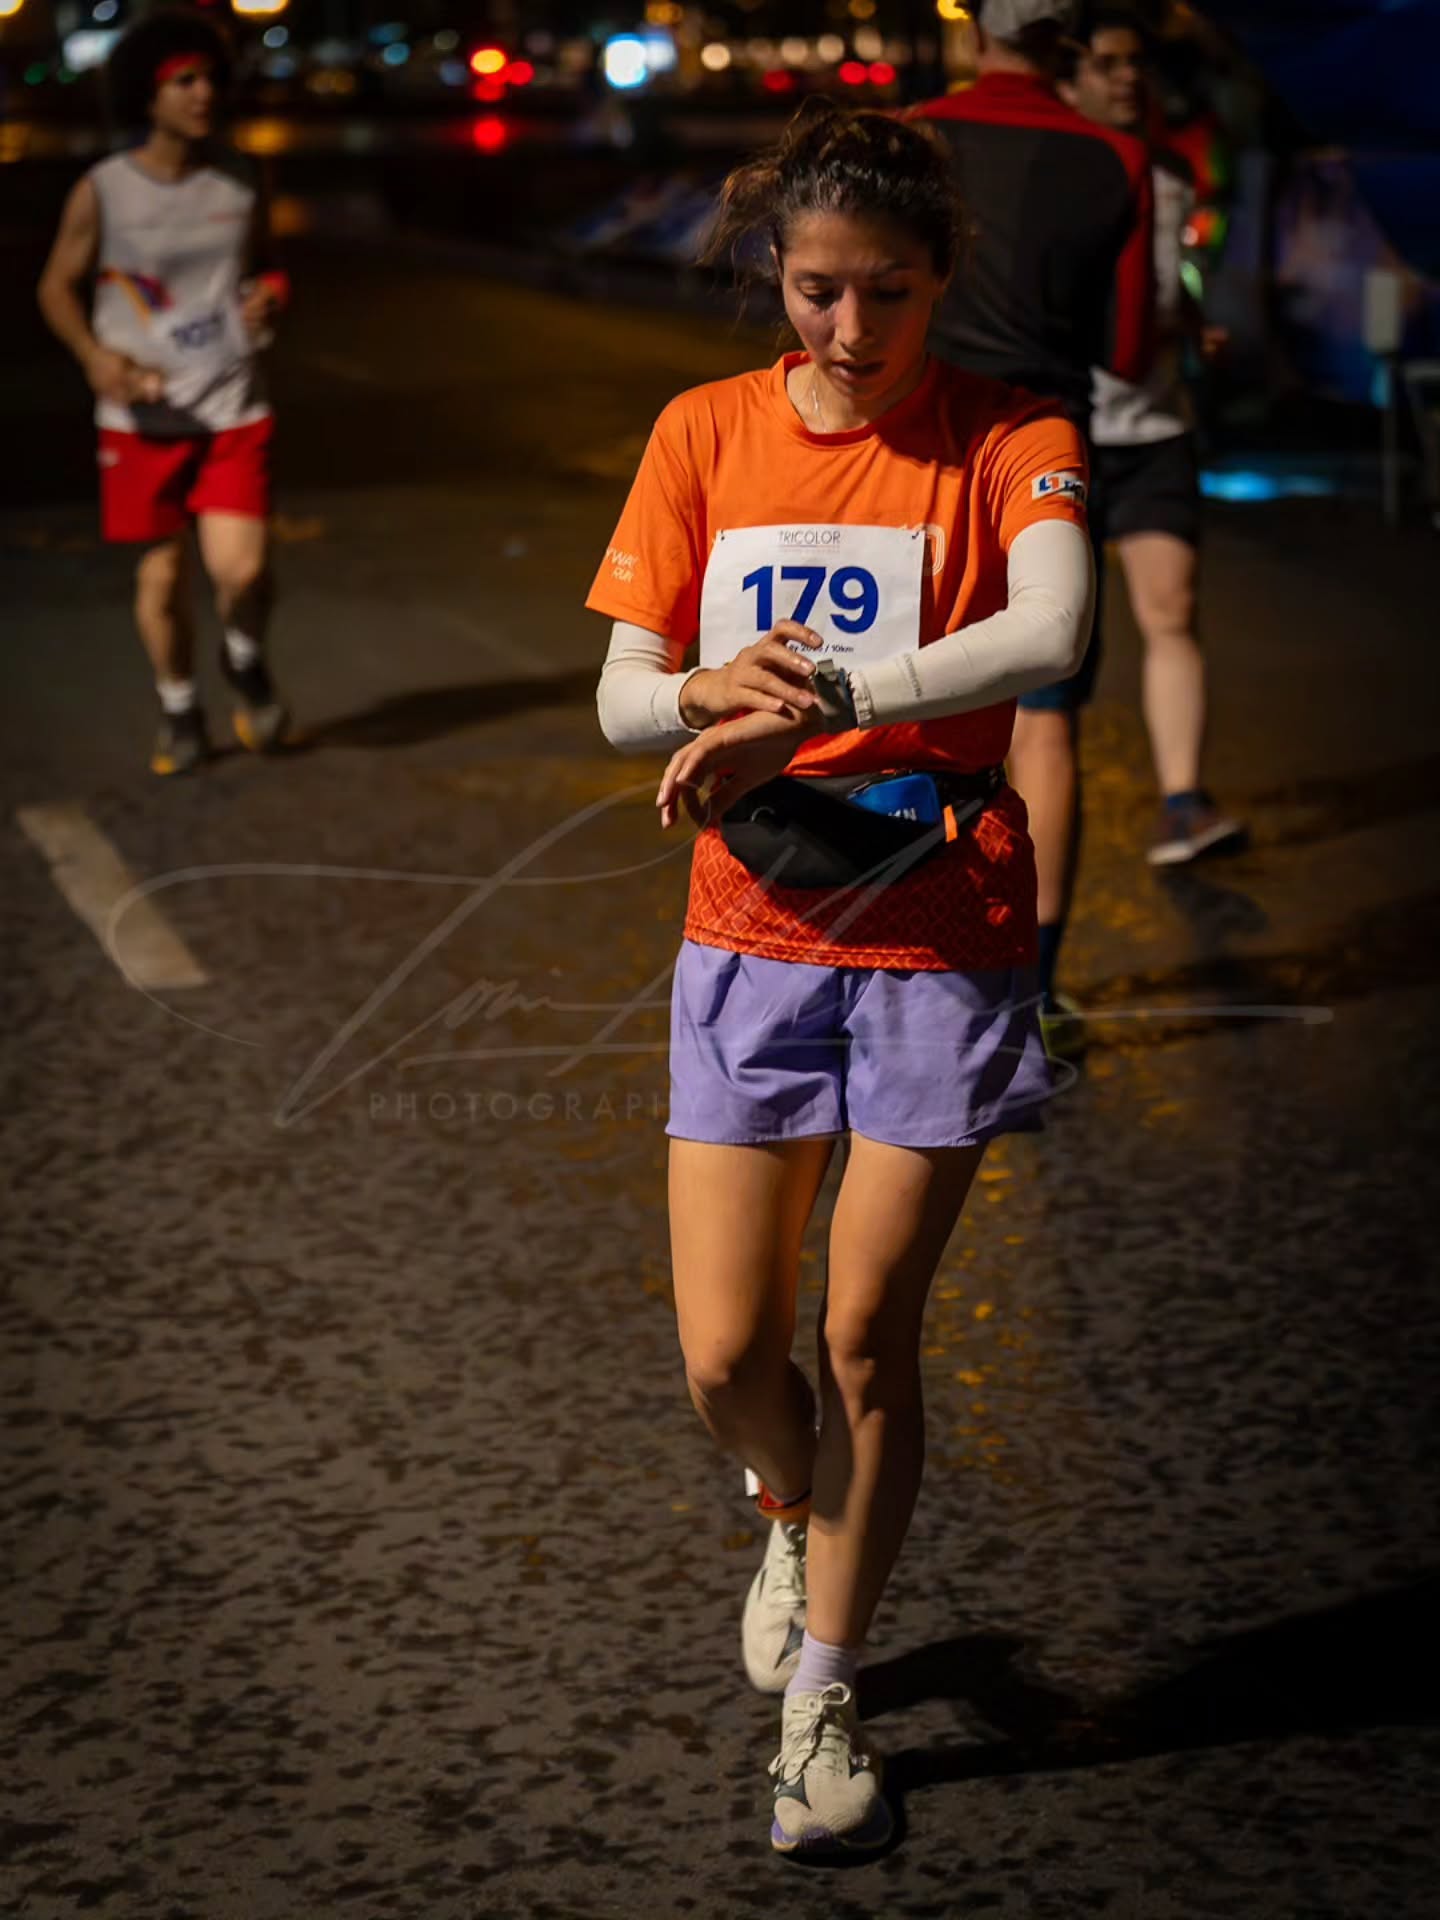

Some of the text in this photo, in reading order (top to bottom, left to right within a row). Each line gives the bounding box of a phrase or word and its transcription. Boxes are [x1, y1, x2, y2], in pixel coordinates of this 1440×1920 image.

[778, 530, 841, 545] TRICOLOR
[742, 565, 879, 634] 179
[831, 642, 855, 653] 10km
